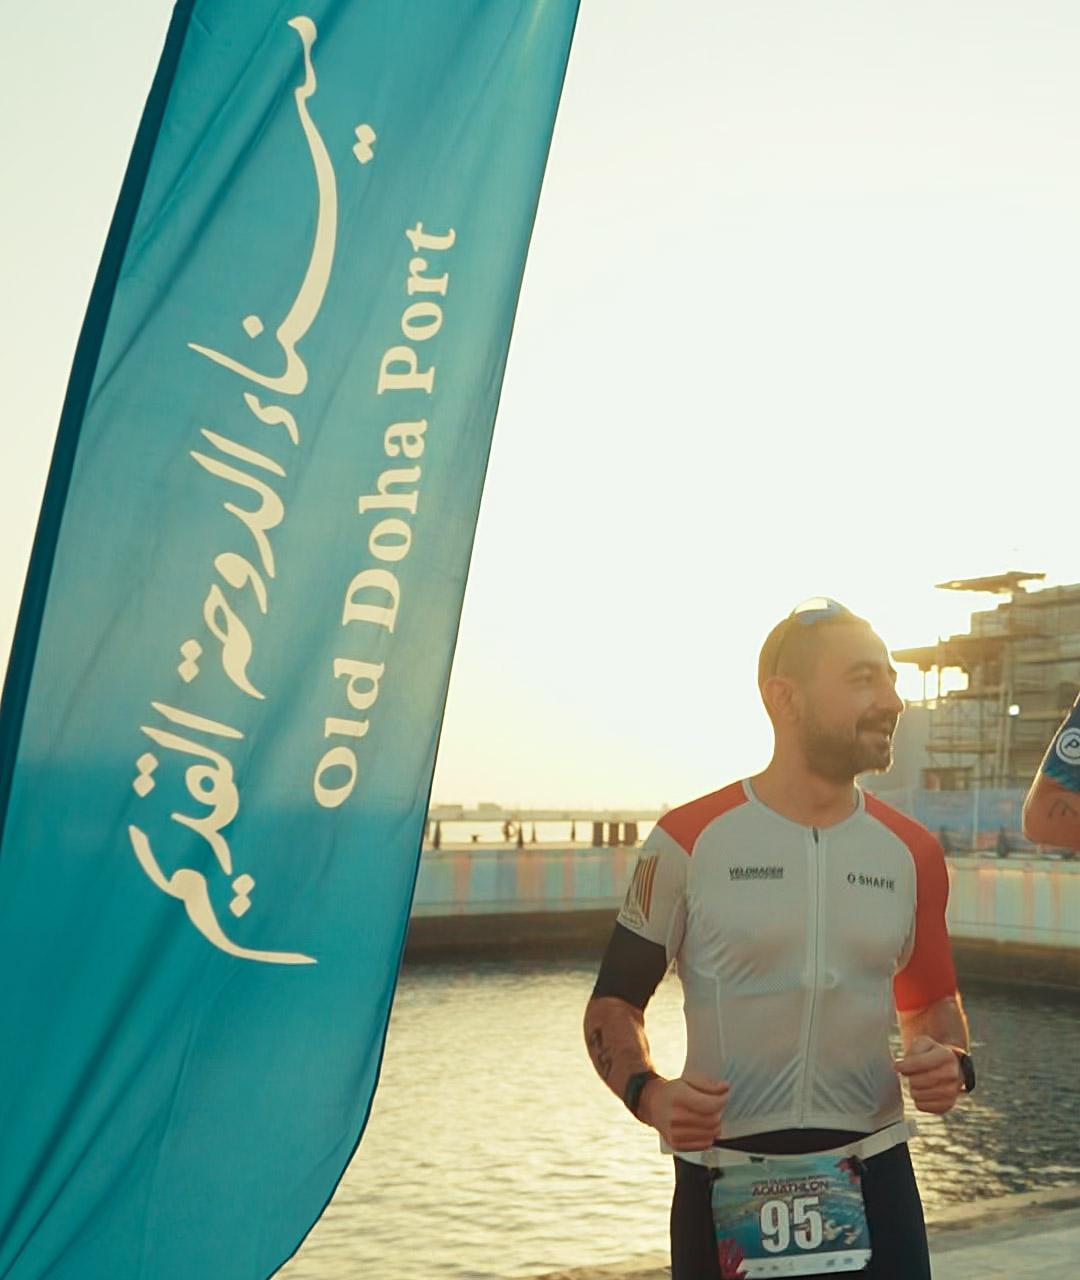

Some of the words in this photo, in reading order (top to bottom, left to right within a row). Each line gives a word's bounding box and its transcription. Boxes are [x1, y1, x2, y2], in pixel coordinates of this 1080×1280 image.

[377, 221, 457, 396] Port
[342, 418, 429, 649] Doha
[313, 652, 388, 808] Old
[751, 1180, 830, 1197] AQUATHLON
[760, 1196, 823, 1253] 95
